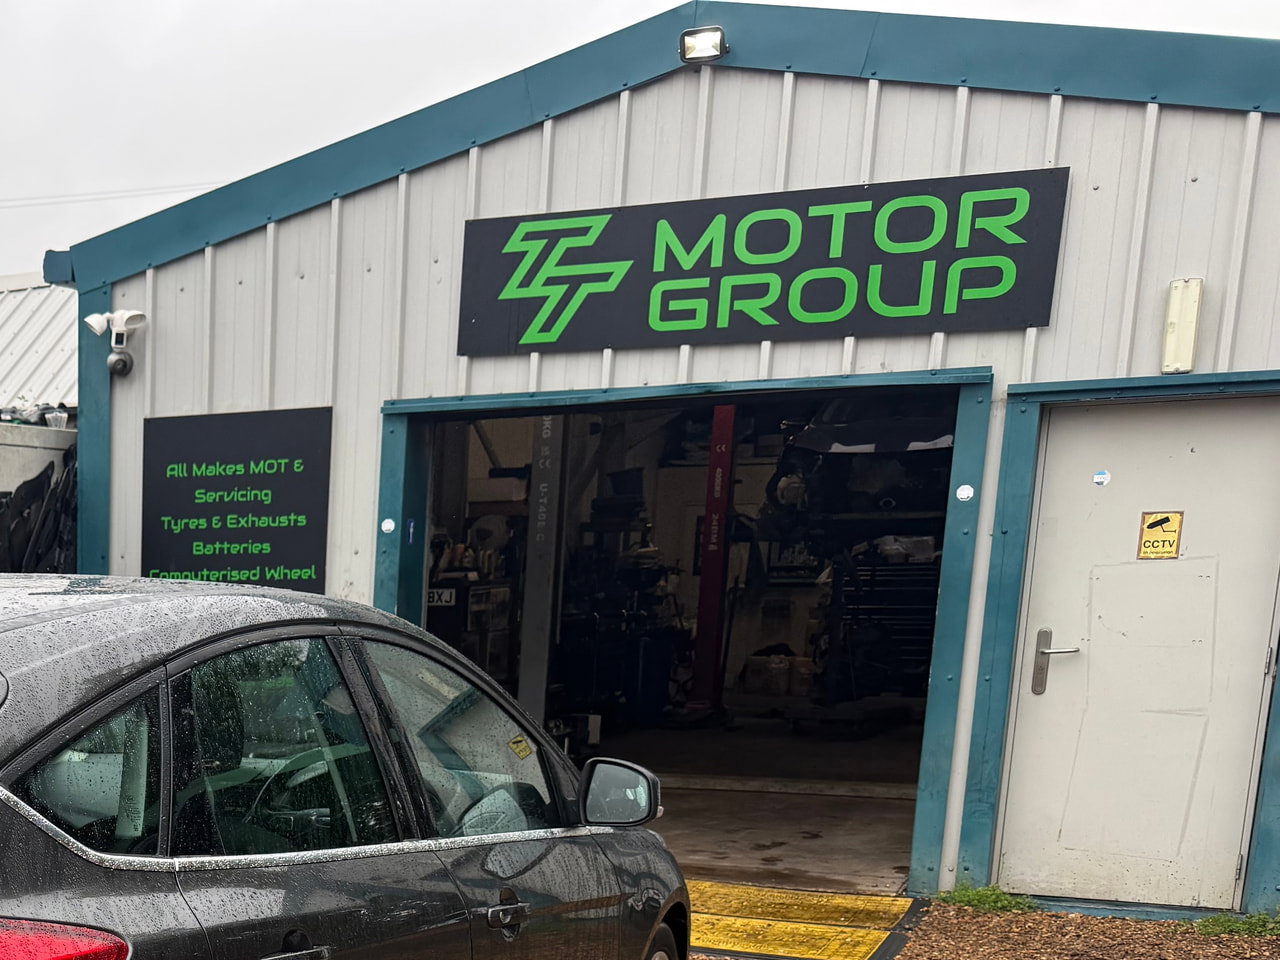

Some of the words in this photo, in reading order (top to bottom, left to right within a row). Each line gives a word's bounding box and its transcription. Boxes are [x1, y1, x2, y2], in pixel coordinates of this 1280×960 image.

[653, 187, 1029, 273] MOTOR
[648, 255, 1017, 332] GROUP
[166, 463, 188, 478] All
[192, 461, 245, 477] Makes
[250, 459, 289, 475] MOT
[294, 459, 304, 472] &
[195, 487, 272, 505] Servicing
[161, 515, 208, 534] Tyres
[212, 515, 222, 529] &
[227, 512, 307, 529] Exhausts
[192, 540, 271, 555] Batteries
[1143, 539, 1176, 549] CCTV
[265, 565, 317, 580] Wheel
